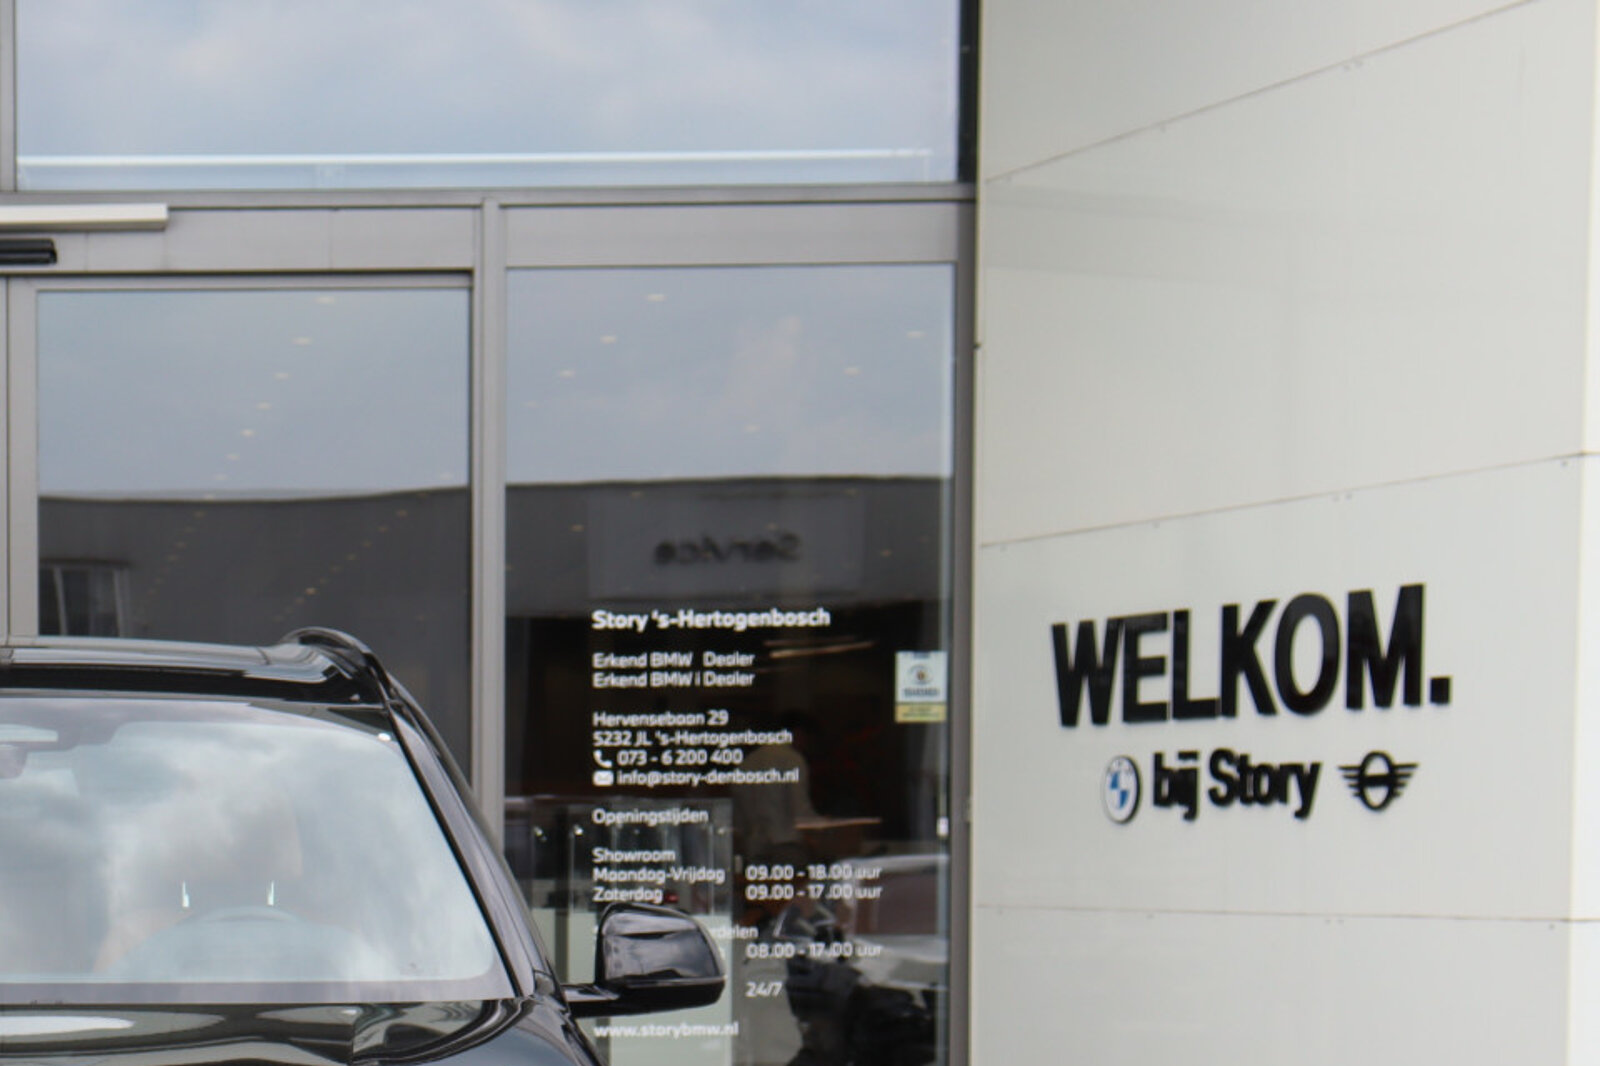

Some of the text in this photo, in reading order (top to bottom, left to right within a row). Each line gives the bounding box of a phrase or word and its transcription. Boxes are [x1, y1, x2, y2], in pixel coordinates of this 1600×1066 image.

[591, 610, 649, 631] Story
[592, 650, 755, 668] Erkend BMW Dealer
[1051, 583, 1452, 728] WELKOM.
[592, 671, 647, 688] Erkend
[650, 671, 693, 687] BMW
[703, 670, 755, 687] Dealer
[592, 709, 729, 727] Hervensebaan 29
[592, 731, 632, 747] 5232
[616, 749, 647, 766] 073
[661, 750, 673, 766] 6
[675, 749, 708, 765] 200
[710, 748, 744, 764] 400
[616, 766, 800, 788] info@story-denbosch.nl
[1152, 747, 1323, 822] bij Story
[592, 808, 709, 827] Openingstijden
[592, 847, 676, 863] Showroom
[592, 866, 725, 884] Maandag-Vrijdag
[745, 864, 794, 881] 09.00
[807, 863, 852, 881] 18.00
[856, 866, 883, 880] uur
[592, 886, 664, 904] Zaterdag
[745, 883, 794, 900] 09.00
[856, 885, 883, 899] uur
[745, 942, 795, 959] 08.00
[856, 944, 883, 958] uur
[745, 980, 783, 997] 24/7
[593, 1020, 739, 1039] www.storybmw.nl
